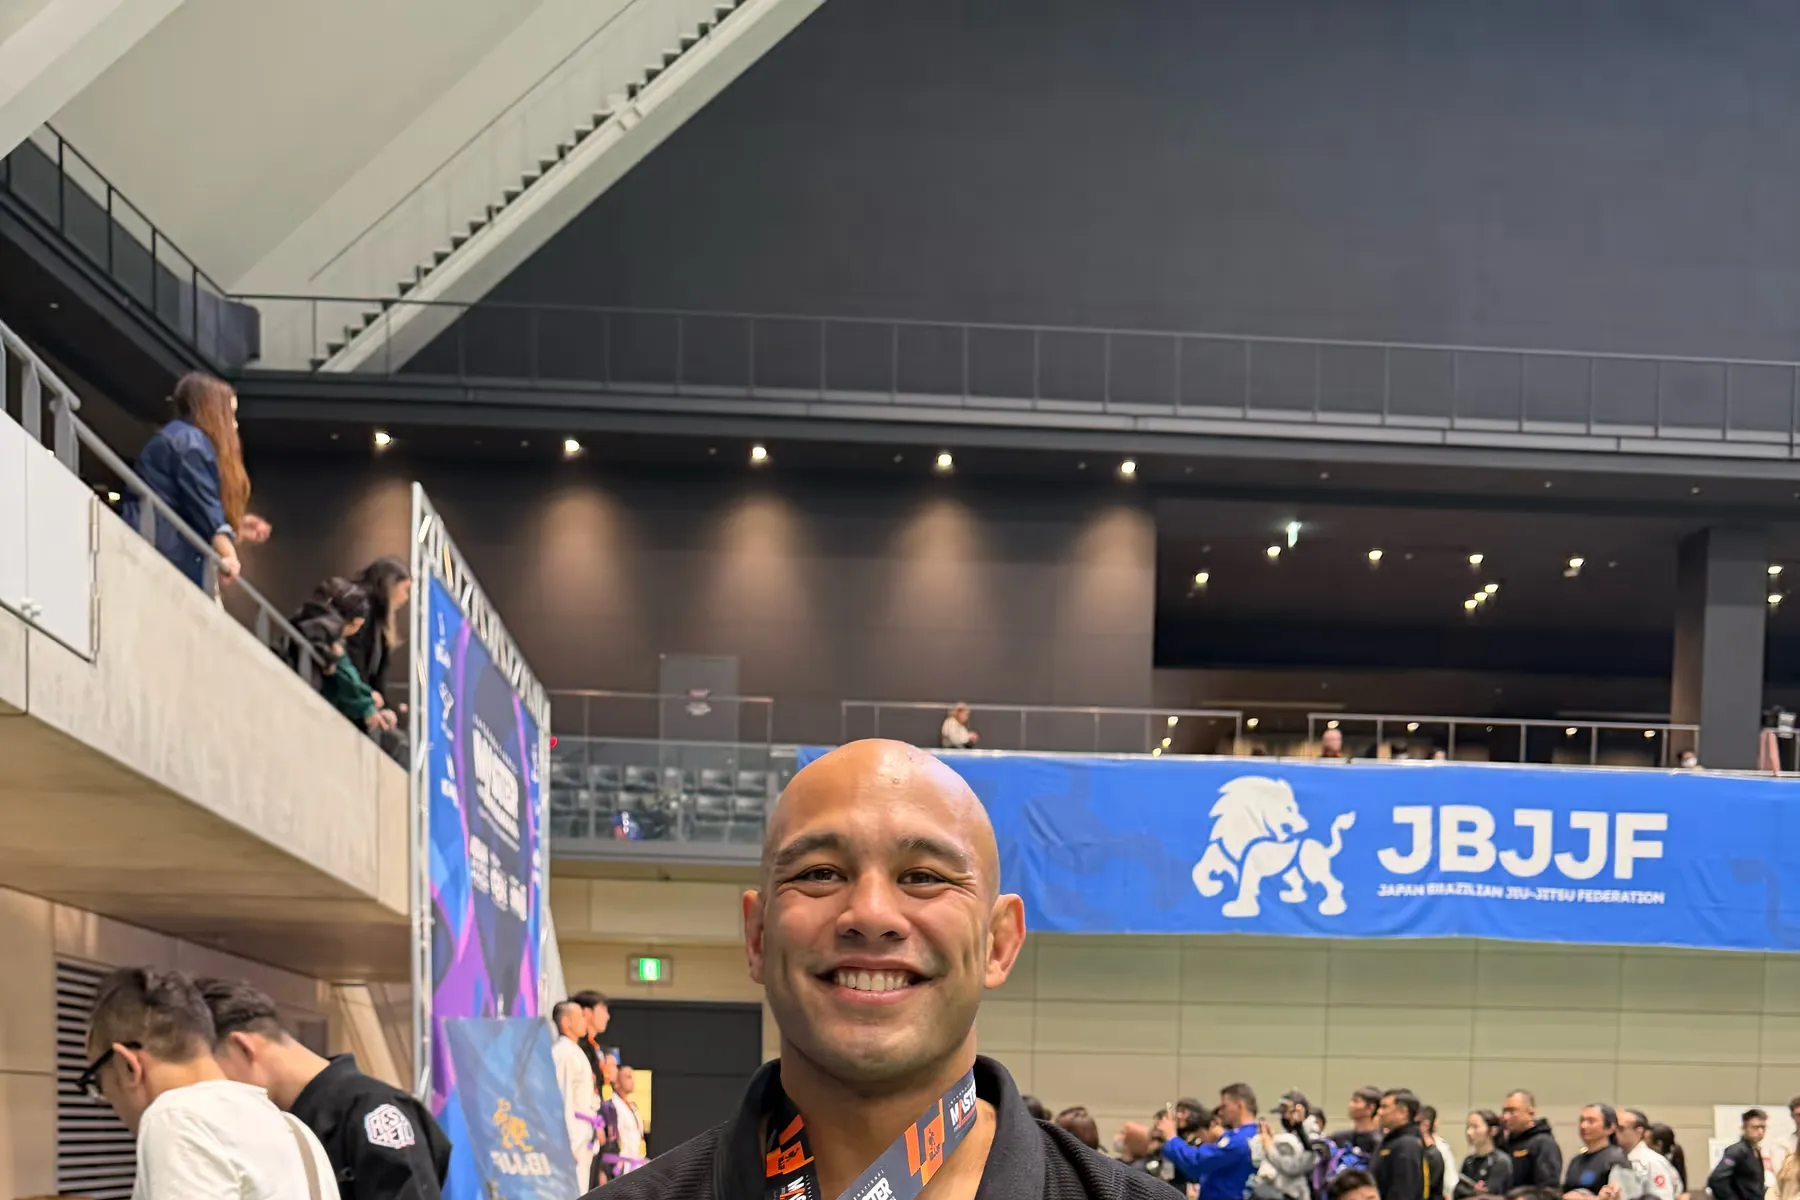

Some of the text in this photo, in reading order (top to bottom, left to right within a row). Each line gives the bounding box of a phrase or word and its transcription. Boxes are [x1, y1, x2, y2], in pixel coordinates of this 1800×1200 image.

[1377, 804, 1668, 880] JBJJF
[1378, 882, 1666, 905] JAPAN BRAZILIAN JIU-JITSU FEDERATION
